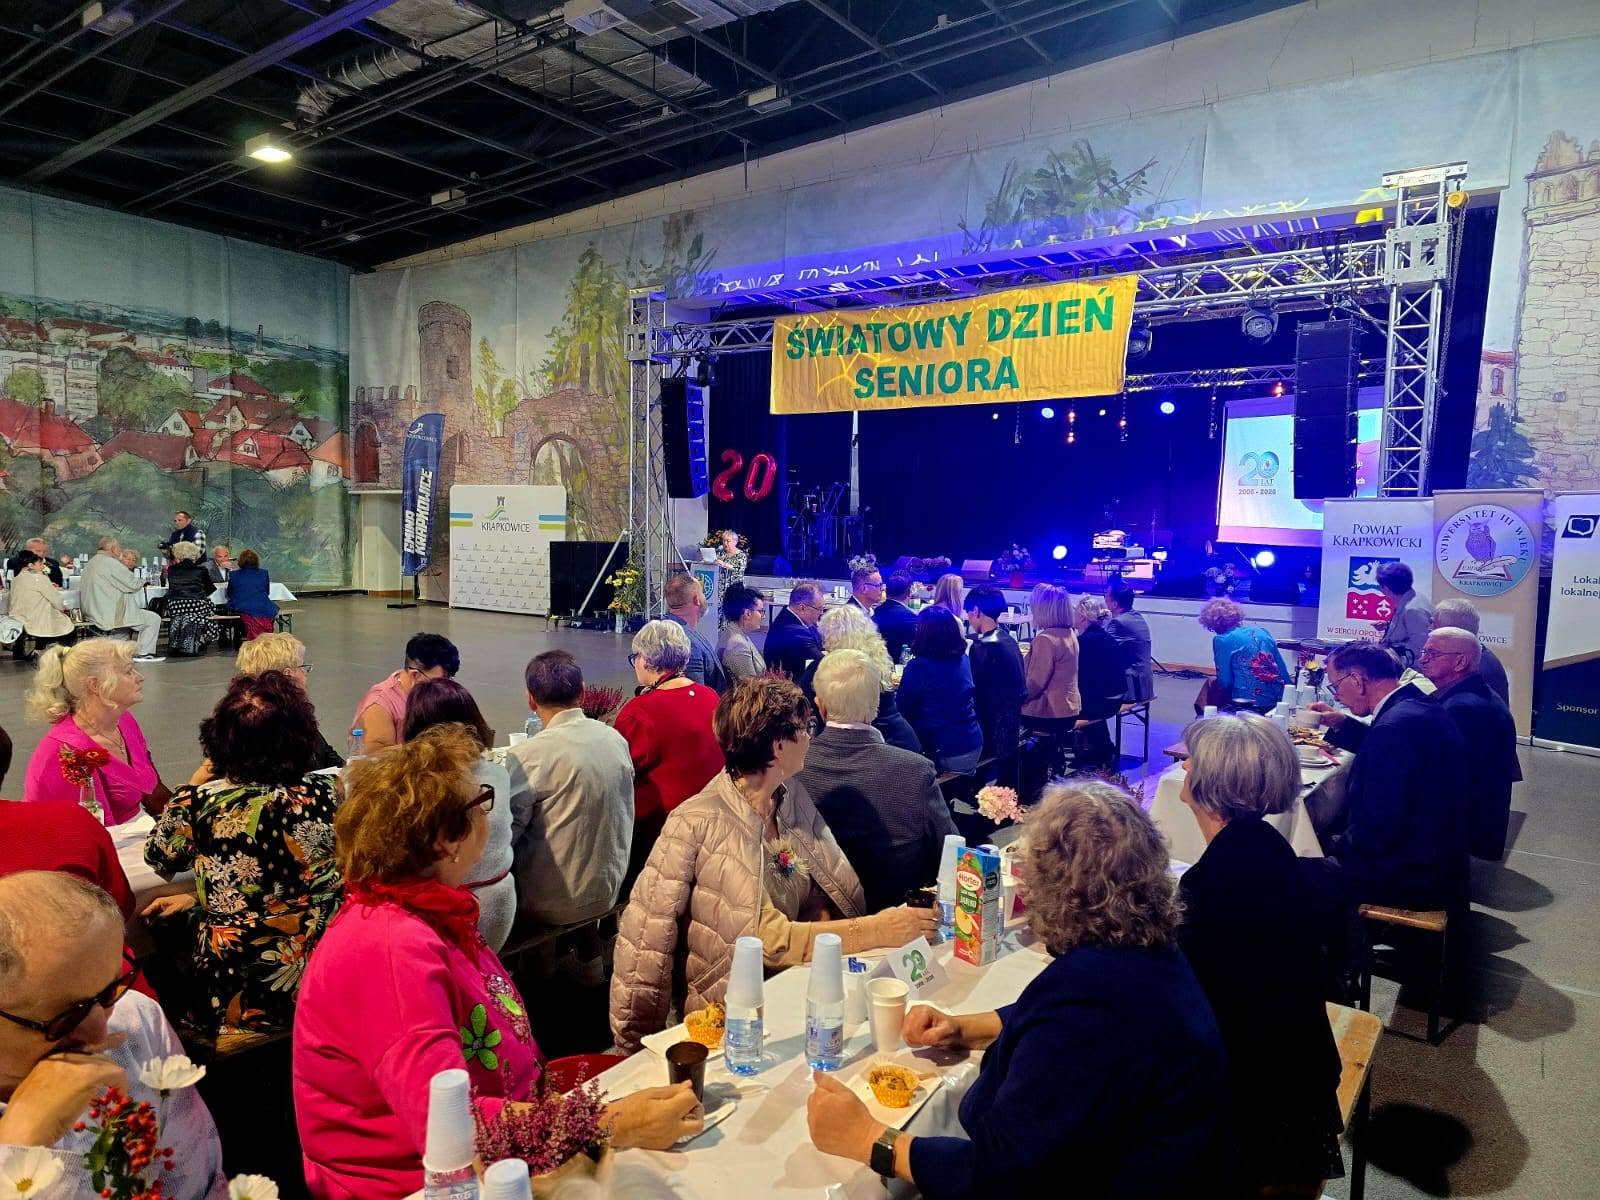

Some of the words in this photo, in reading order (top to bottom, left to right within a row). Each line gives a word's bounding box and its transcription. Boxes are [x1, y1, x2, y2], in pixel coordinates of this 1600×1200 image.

[786, 311, 972, 360] ŚWIATOWY
[987, 287, 1115, 343] DZIEŃ
[853, 355, 1020, 399] SENIORA
[712, 448, 777, 502] 20
[1238, 451, 1279, 486] 20
[415, 468, 433, 556] KRAPKOWICE
[481, 522, 531, 533] KRAPKOWICE
[1353, 523, 1403, 536] POWIAT
[1332, 535, 1423, 549] KRAPKOWICKI
[1556, 702, 1598, 715] Sponsor
